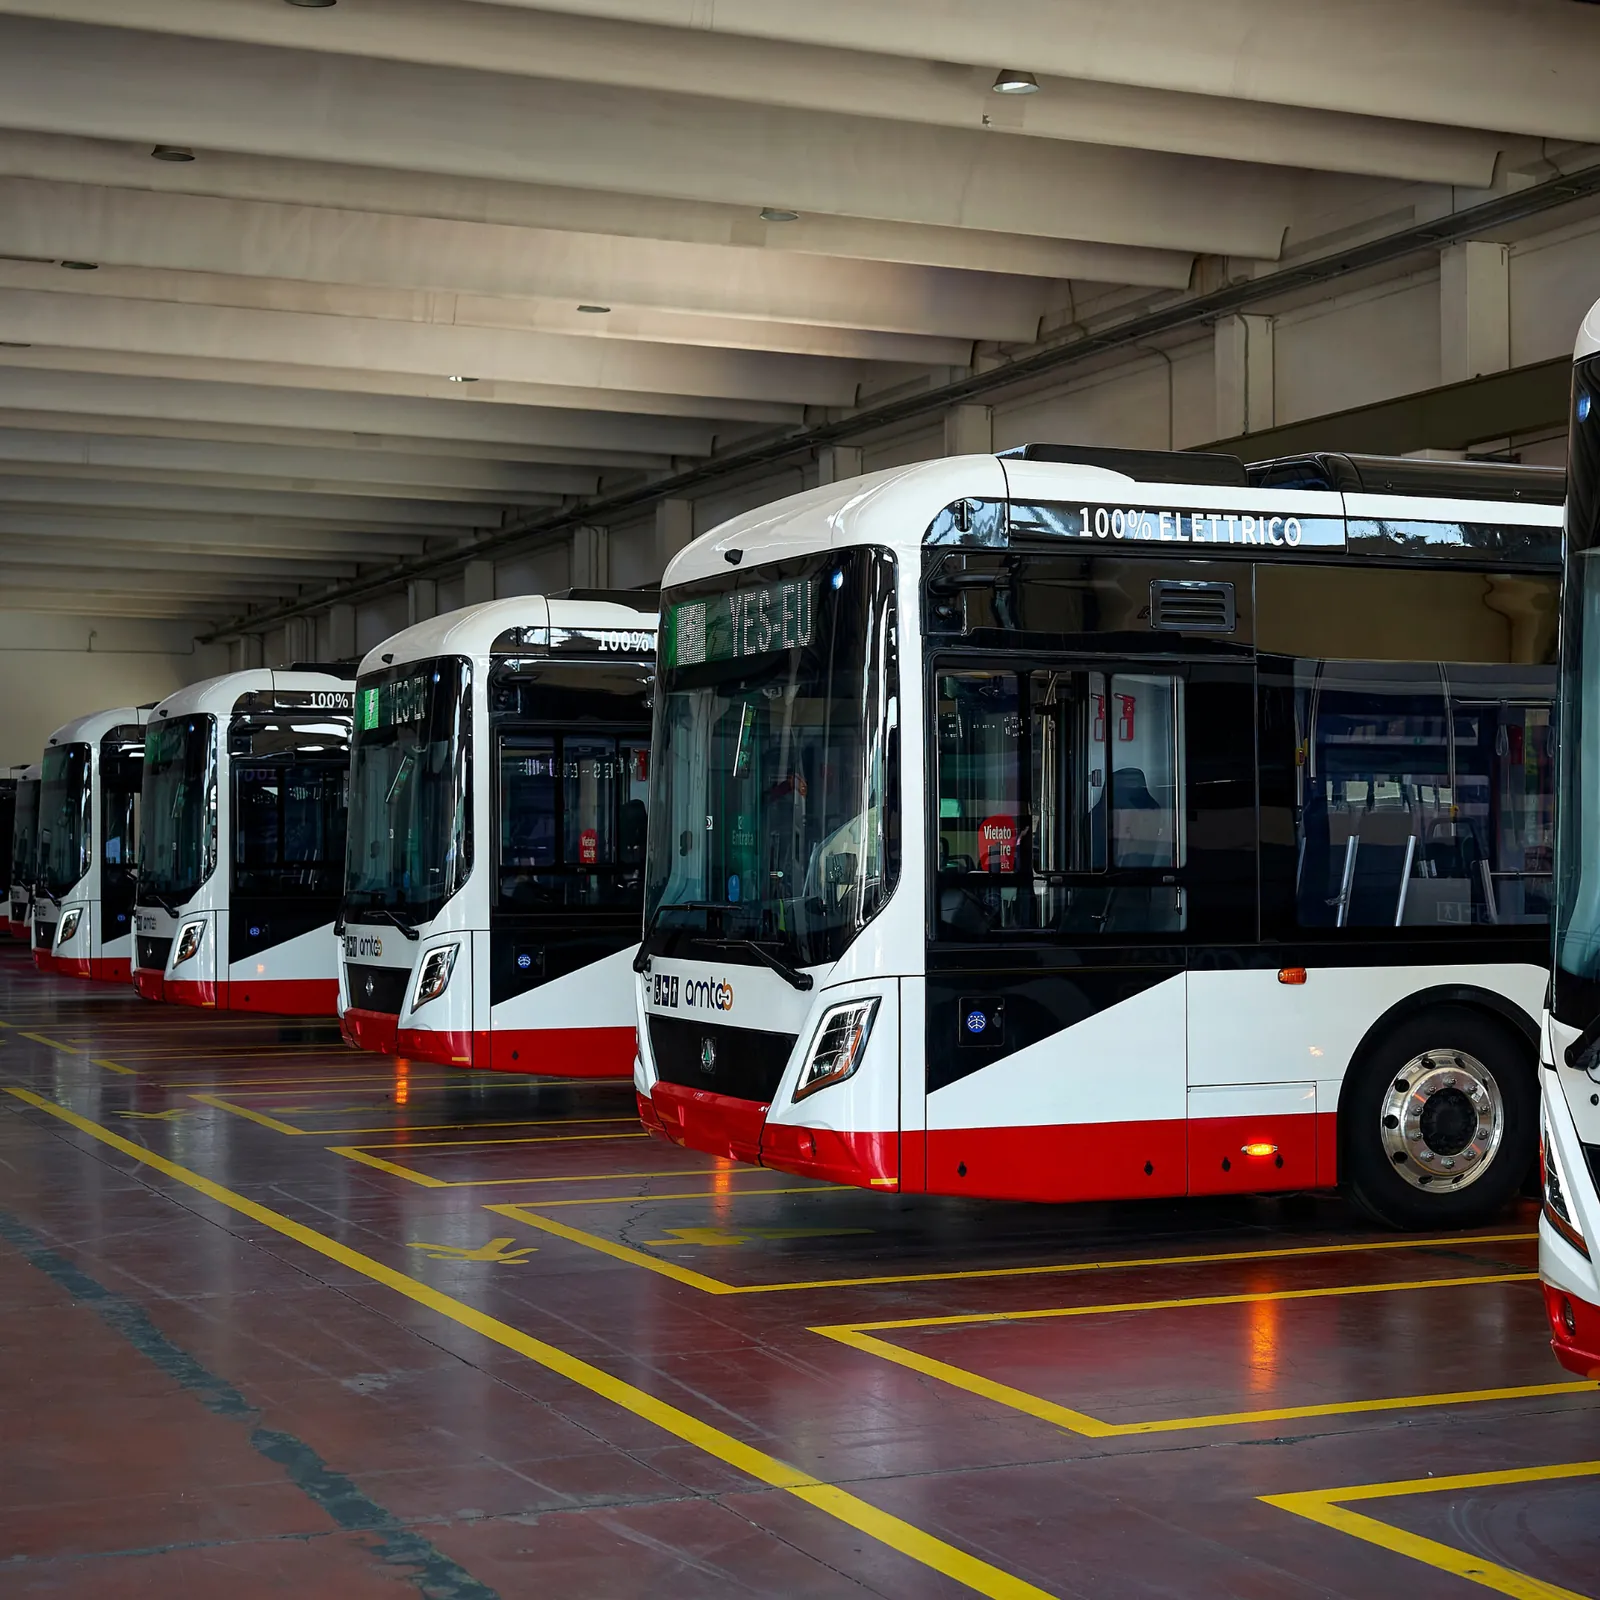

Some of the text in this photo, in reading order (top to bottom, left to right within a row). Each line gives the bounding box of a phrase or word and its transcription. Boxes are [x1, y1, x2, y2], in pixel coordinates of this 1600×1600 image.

[1079, 507, 1302, 547] 100% ELETTRICO
[729, 580, 812, 658] YES-EU
[598, 631, 649, 652] 100%
[310, 693, 349, 708] 100%
[983, 825, 1012, 840] Vietato
